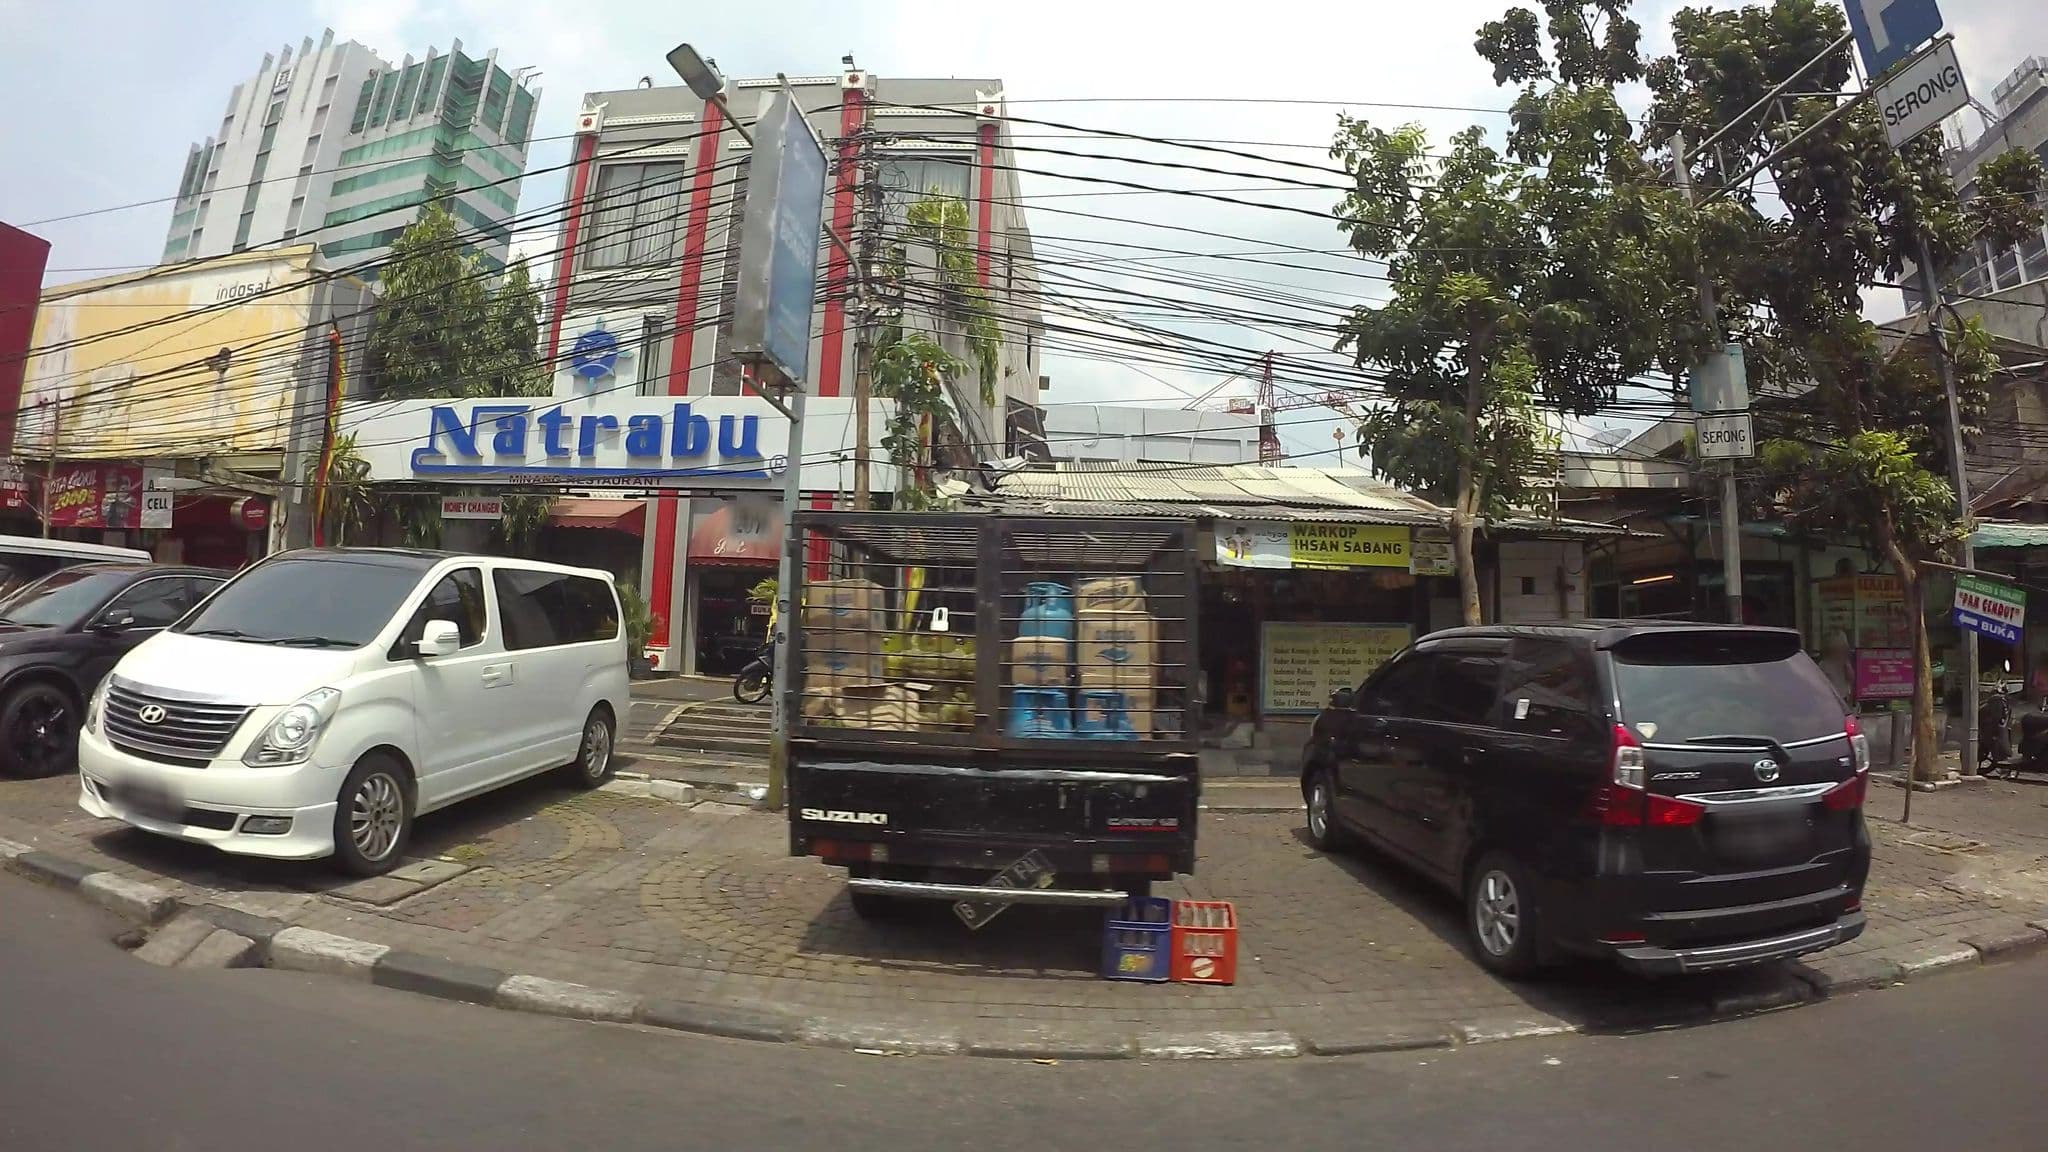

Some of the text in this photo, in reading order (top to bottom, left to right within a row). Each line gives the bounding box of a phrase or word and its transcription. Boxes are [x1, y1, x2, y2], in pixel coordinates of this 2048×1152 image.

[1884, 65, 1959, 127] SERONG
[216, 277, 271, 300] indosat
[412, 402, 764, 470] Natrabu
[1702, 429, 1746, 444] SERONG
[509, 475, 662, 486] MINANG RESTAURANT
[147, 497, 169, 510] CELL
[443, 502, 500, 514] MONEY CHANGER
[1294, 525, 1357, 538] WARKOP
[1294, 539, 1340, 553] IHSAN
[1343, 541, 1402, 555] SABANG
[1981, 621, 2015, 641] BUKA
[800, 807, 889, 825] SUZUKI
